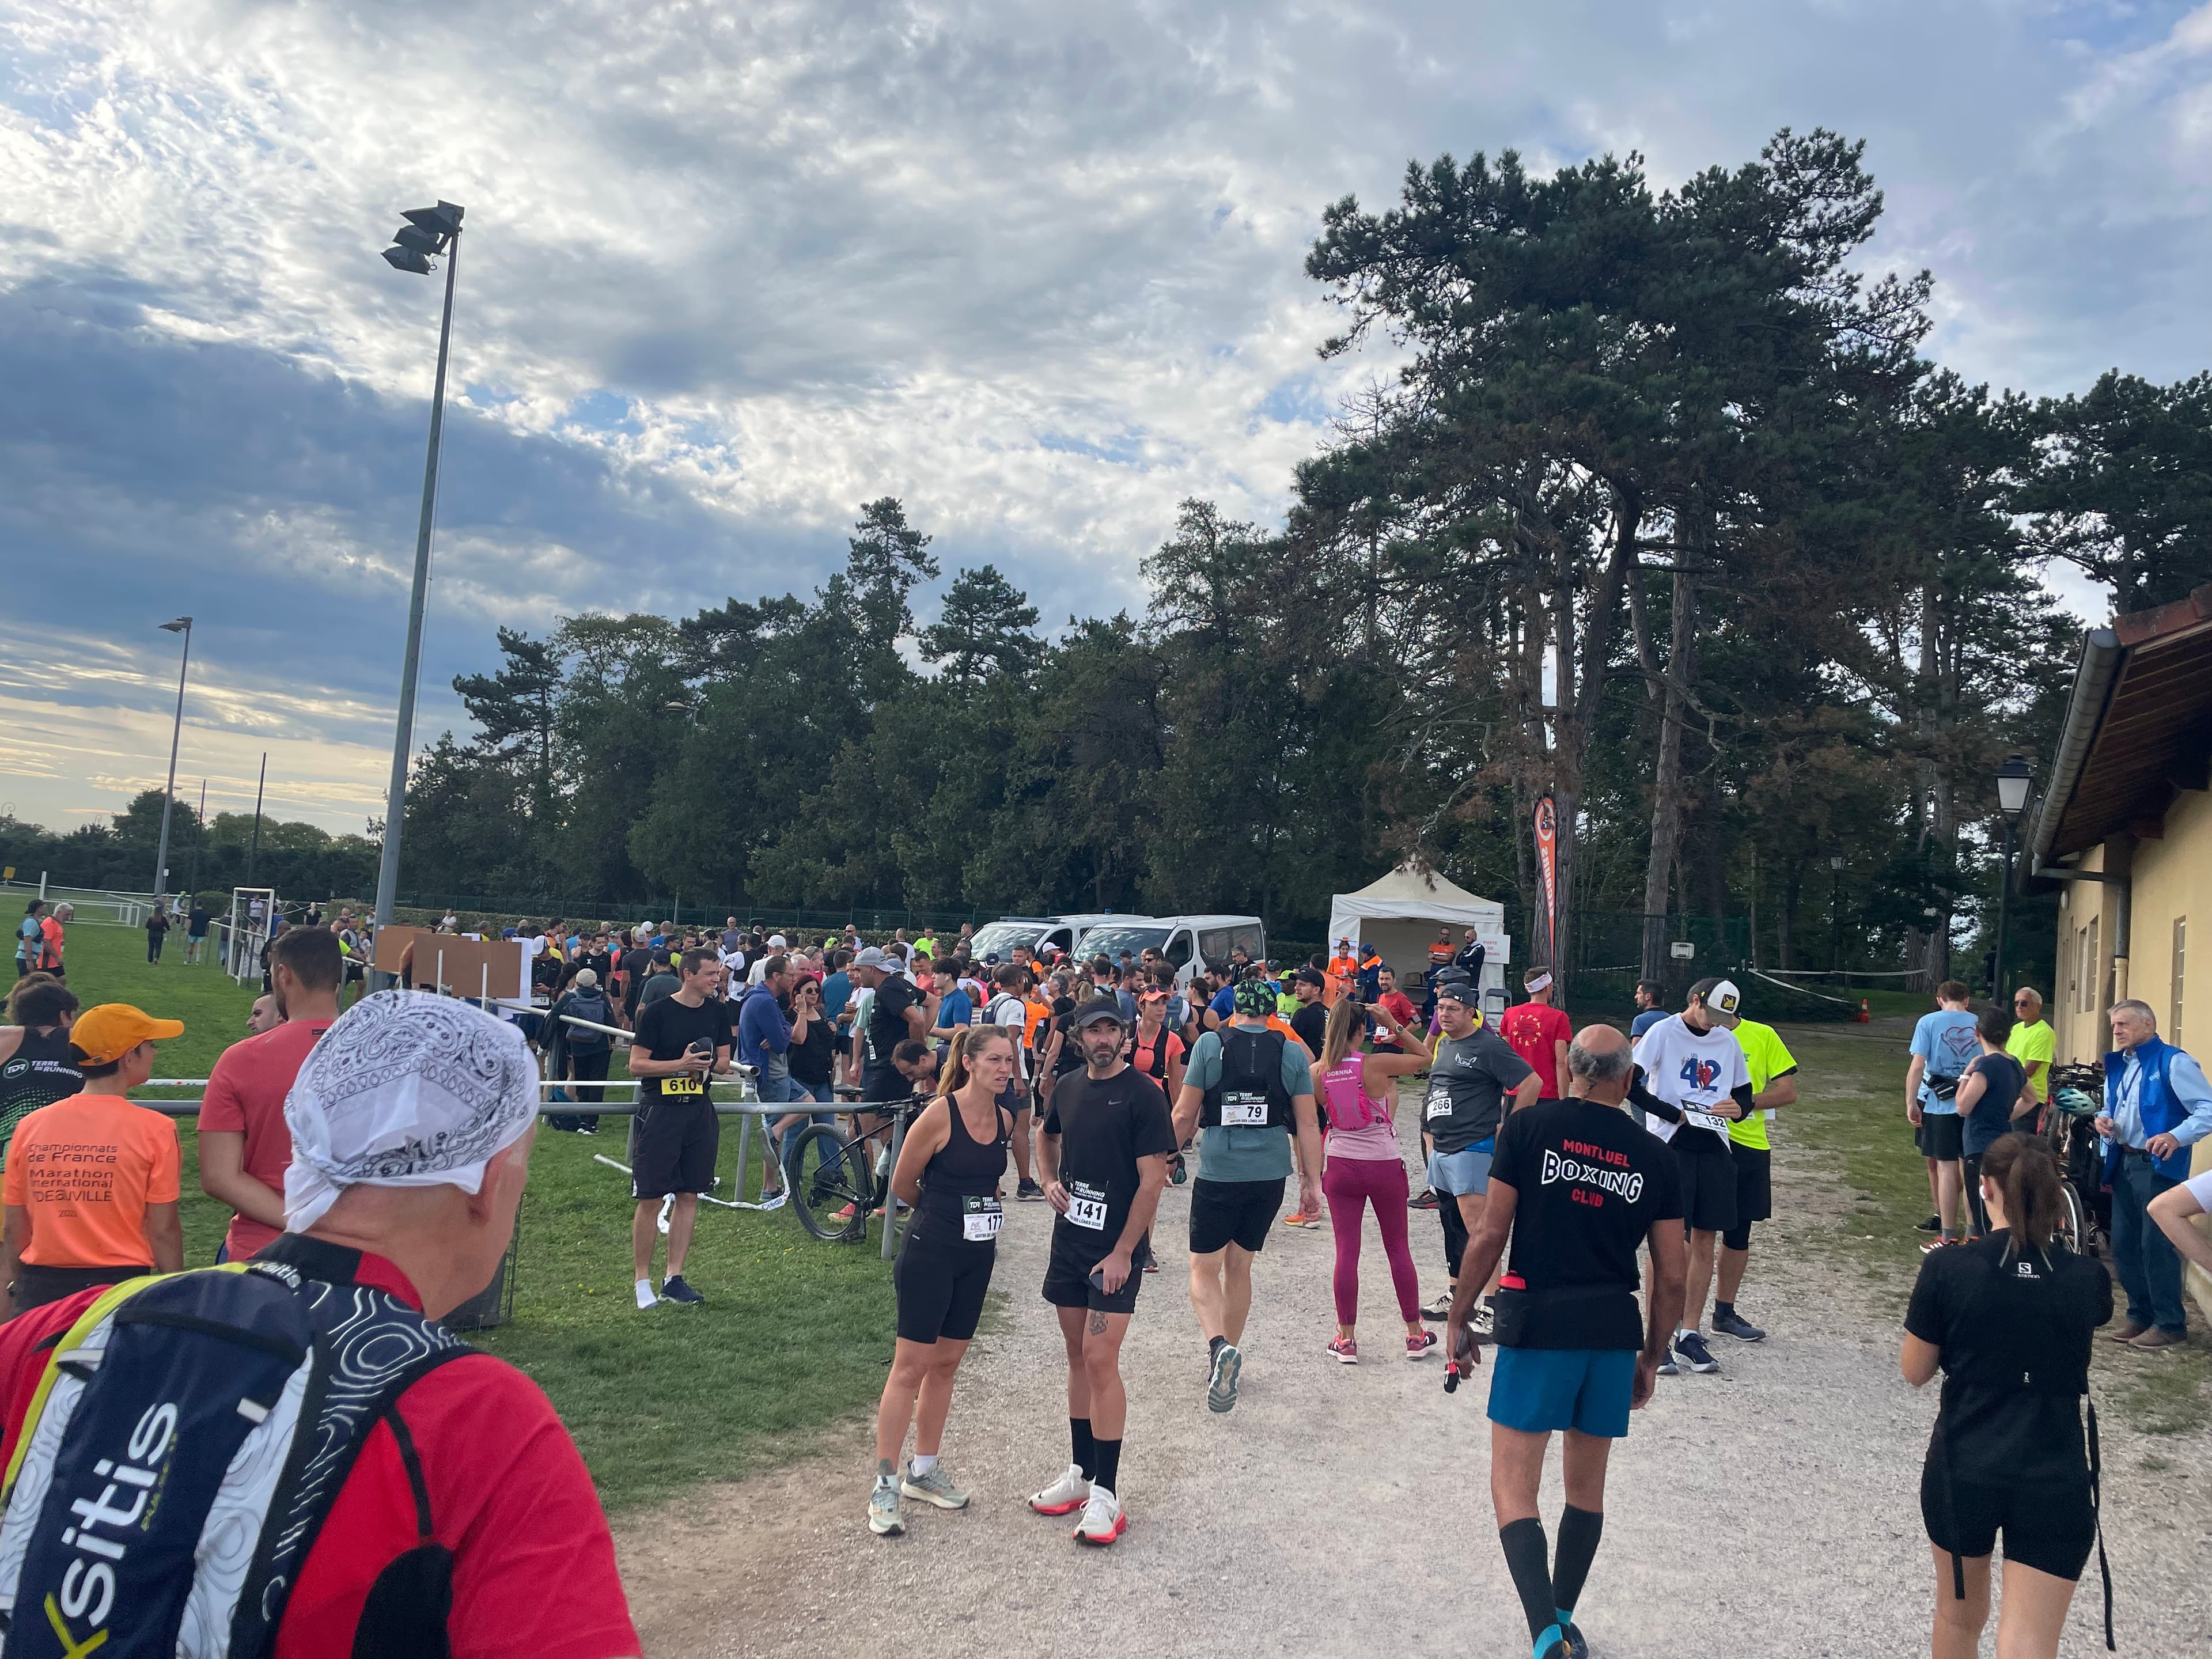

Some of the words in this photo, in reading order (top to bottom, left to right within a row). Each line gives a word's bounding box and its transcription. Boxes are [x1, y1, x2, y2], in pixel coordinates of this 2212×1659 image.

[43, 1066, 83, 1078] RUNNING
[1327, 1069, 1353, 1077] DORNNA
[1680, 1058, 1721, 1092] 42
[669, 1079, 697, 1092] 610
[1433, 1099, 1450, 1112] 266
[1247, 1106, 1262, 1118] 79
[1705, 1116, 1726, 1128] 132
[28, 1152, 46, 1162] de
[52, 1152, 116, 1163] France
[1563, 1139, 1631, 1168] MONTLUEL
[29, 1169, 113, 1179] Marathon
[1541, 1149, 1644, 1204] BOXING
[1075, 1180, 1090, 1190] TERRE
[1080, 1187, 1105, 1198] RUNNING
[1571, 1188, 1604, 1207] CLUB
[1077, 1201, 1103, 1220] 141
[988, 1215, 1003, 1231] 177
